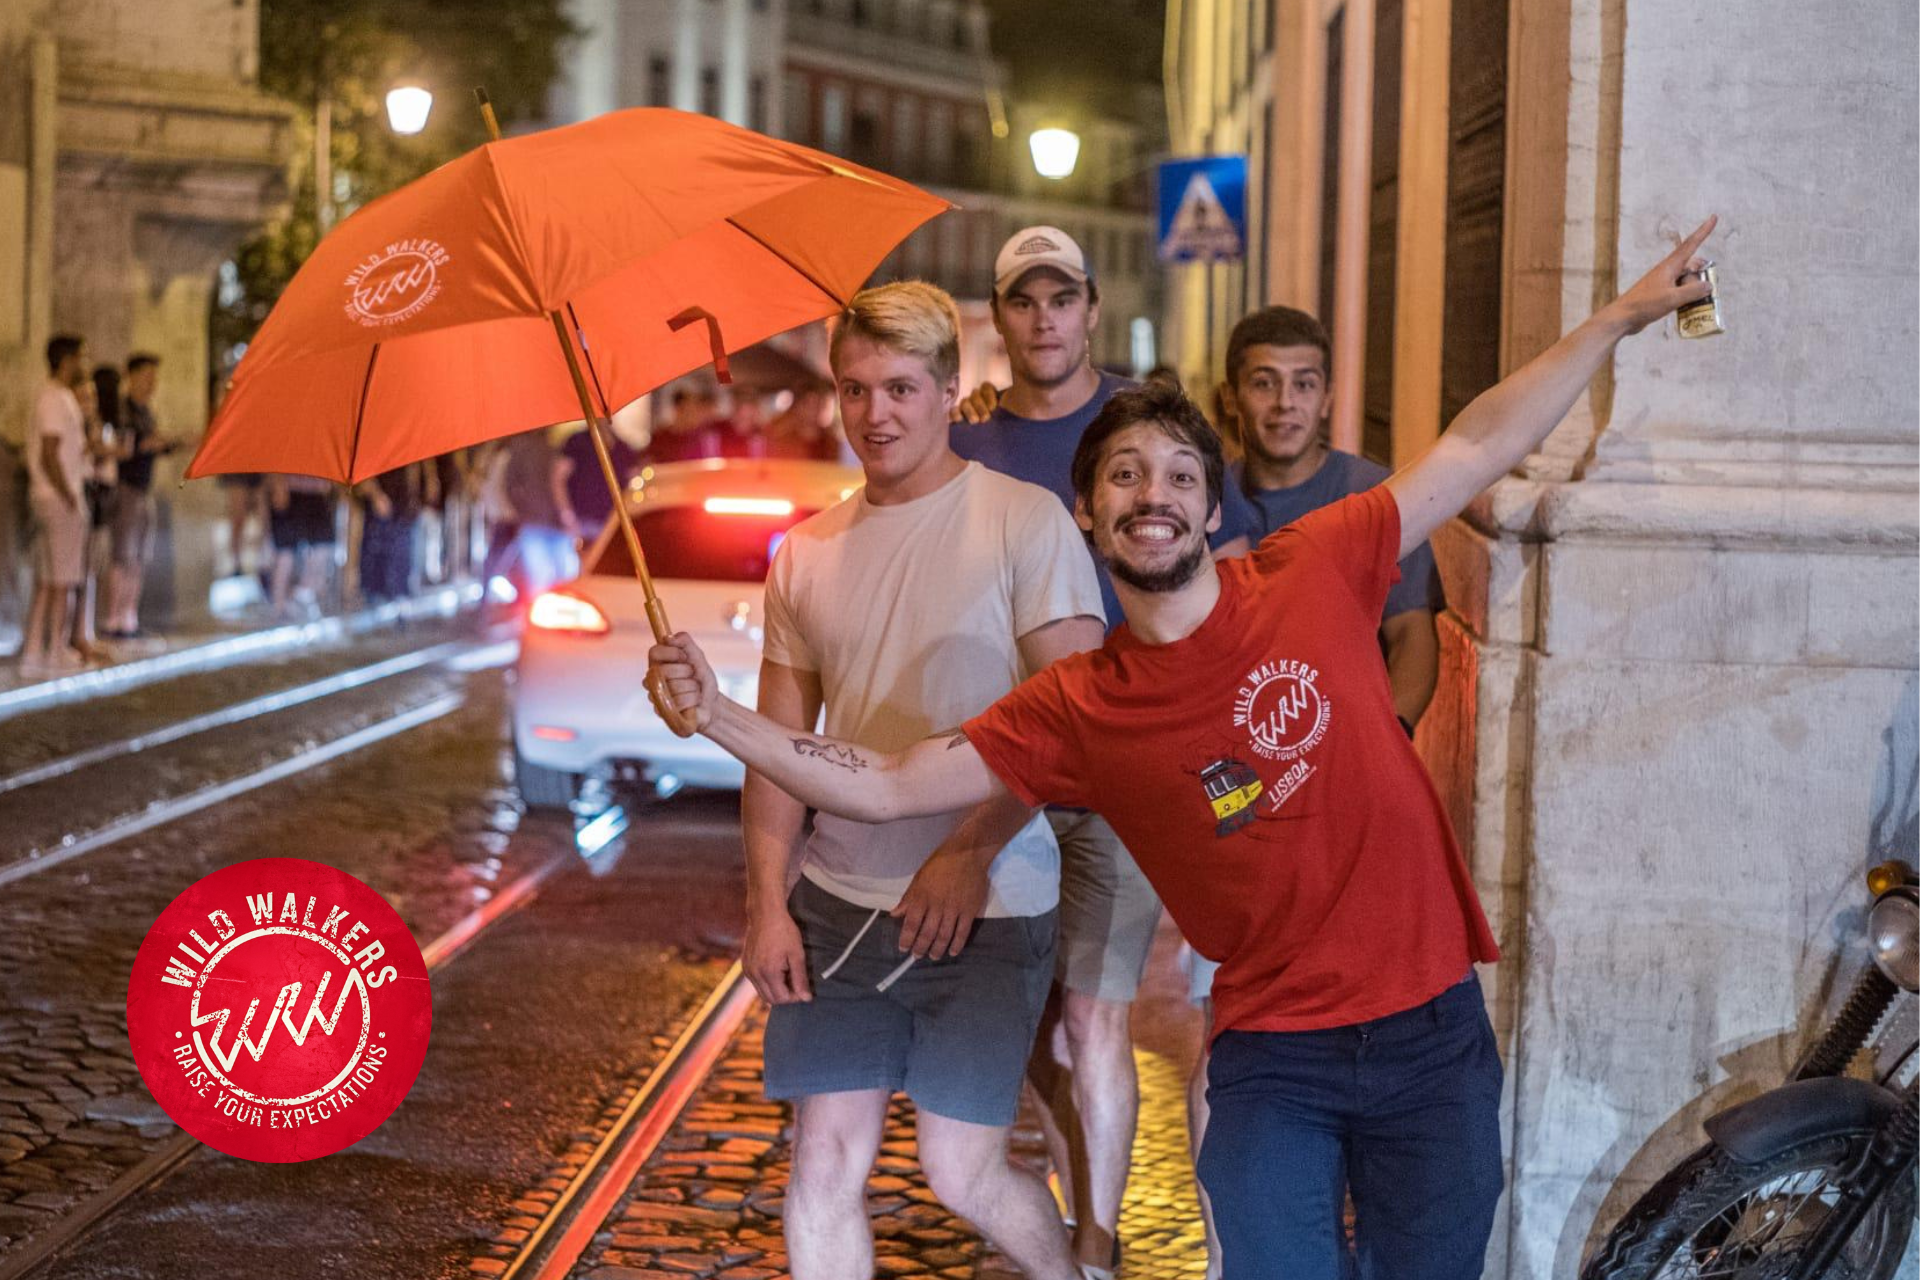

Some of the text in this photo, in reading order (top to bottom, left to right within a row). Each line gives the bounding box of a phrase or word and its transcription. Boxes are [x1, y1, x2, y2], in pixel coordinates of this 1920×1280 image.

[344, 239, 450, 286] WILD WALKERS
[1233, 659, 1319, 727] WILD WALKERS
[1251, 699, 1331, 762] RAISE YOUR EXPECTATIONS
[1267, 758, 1311, 804] LISBOA
